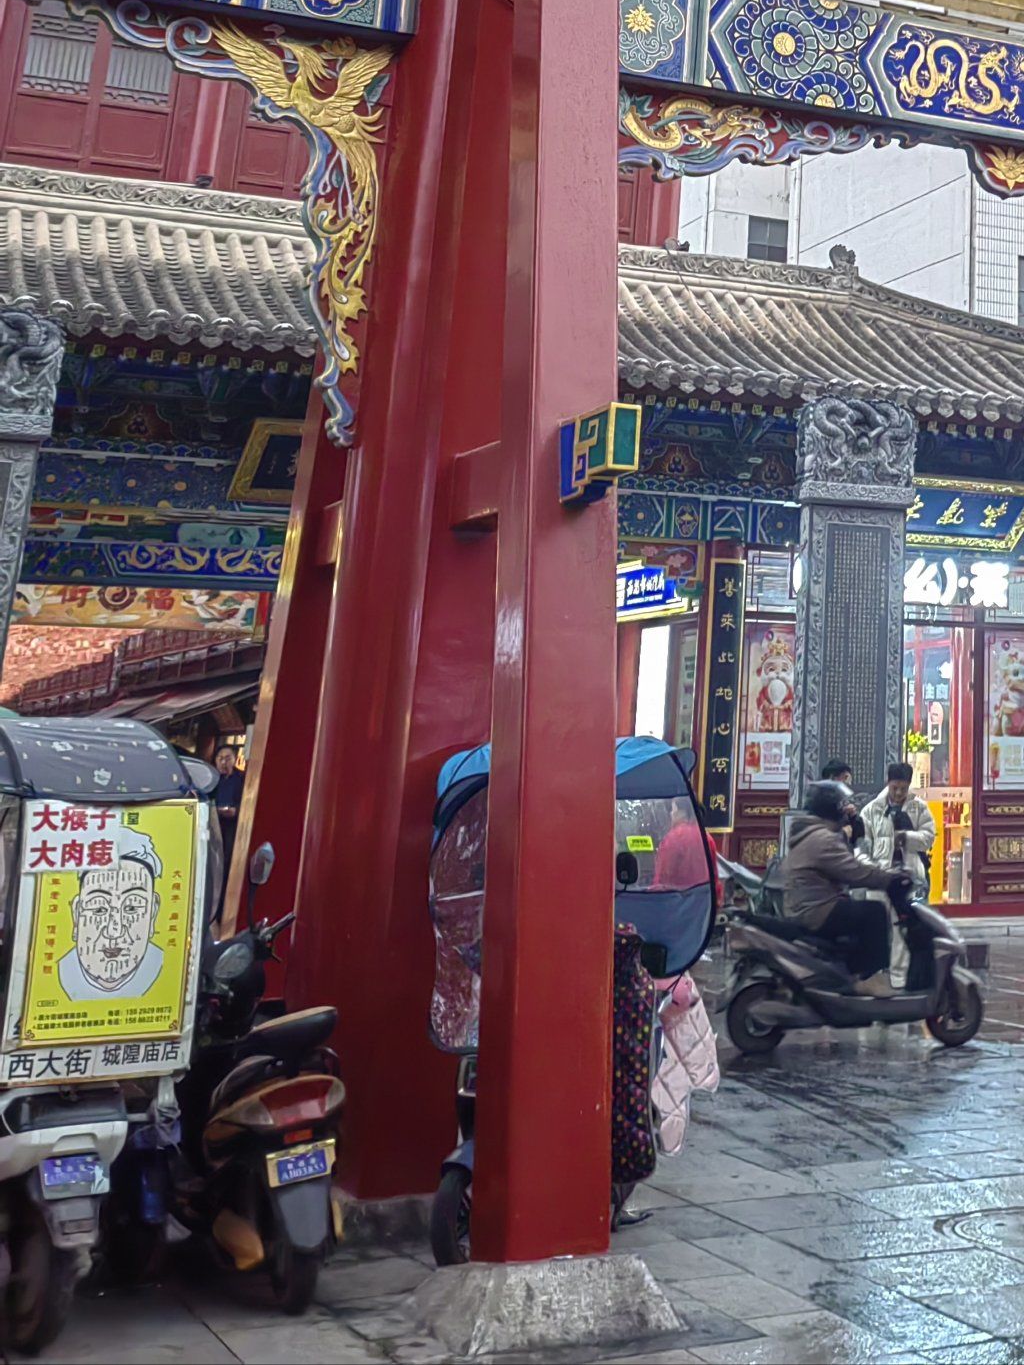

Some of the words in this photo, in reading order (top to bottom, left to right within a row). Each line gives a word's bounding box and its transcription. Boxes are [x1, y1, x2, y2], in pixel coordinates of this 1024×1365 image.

[29, 838, 115, 868] 大肉痣
[8, 1048, 92, 1080] 西大街
[101, 1040, 181, 1067] 城隍庙店
